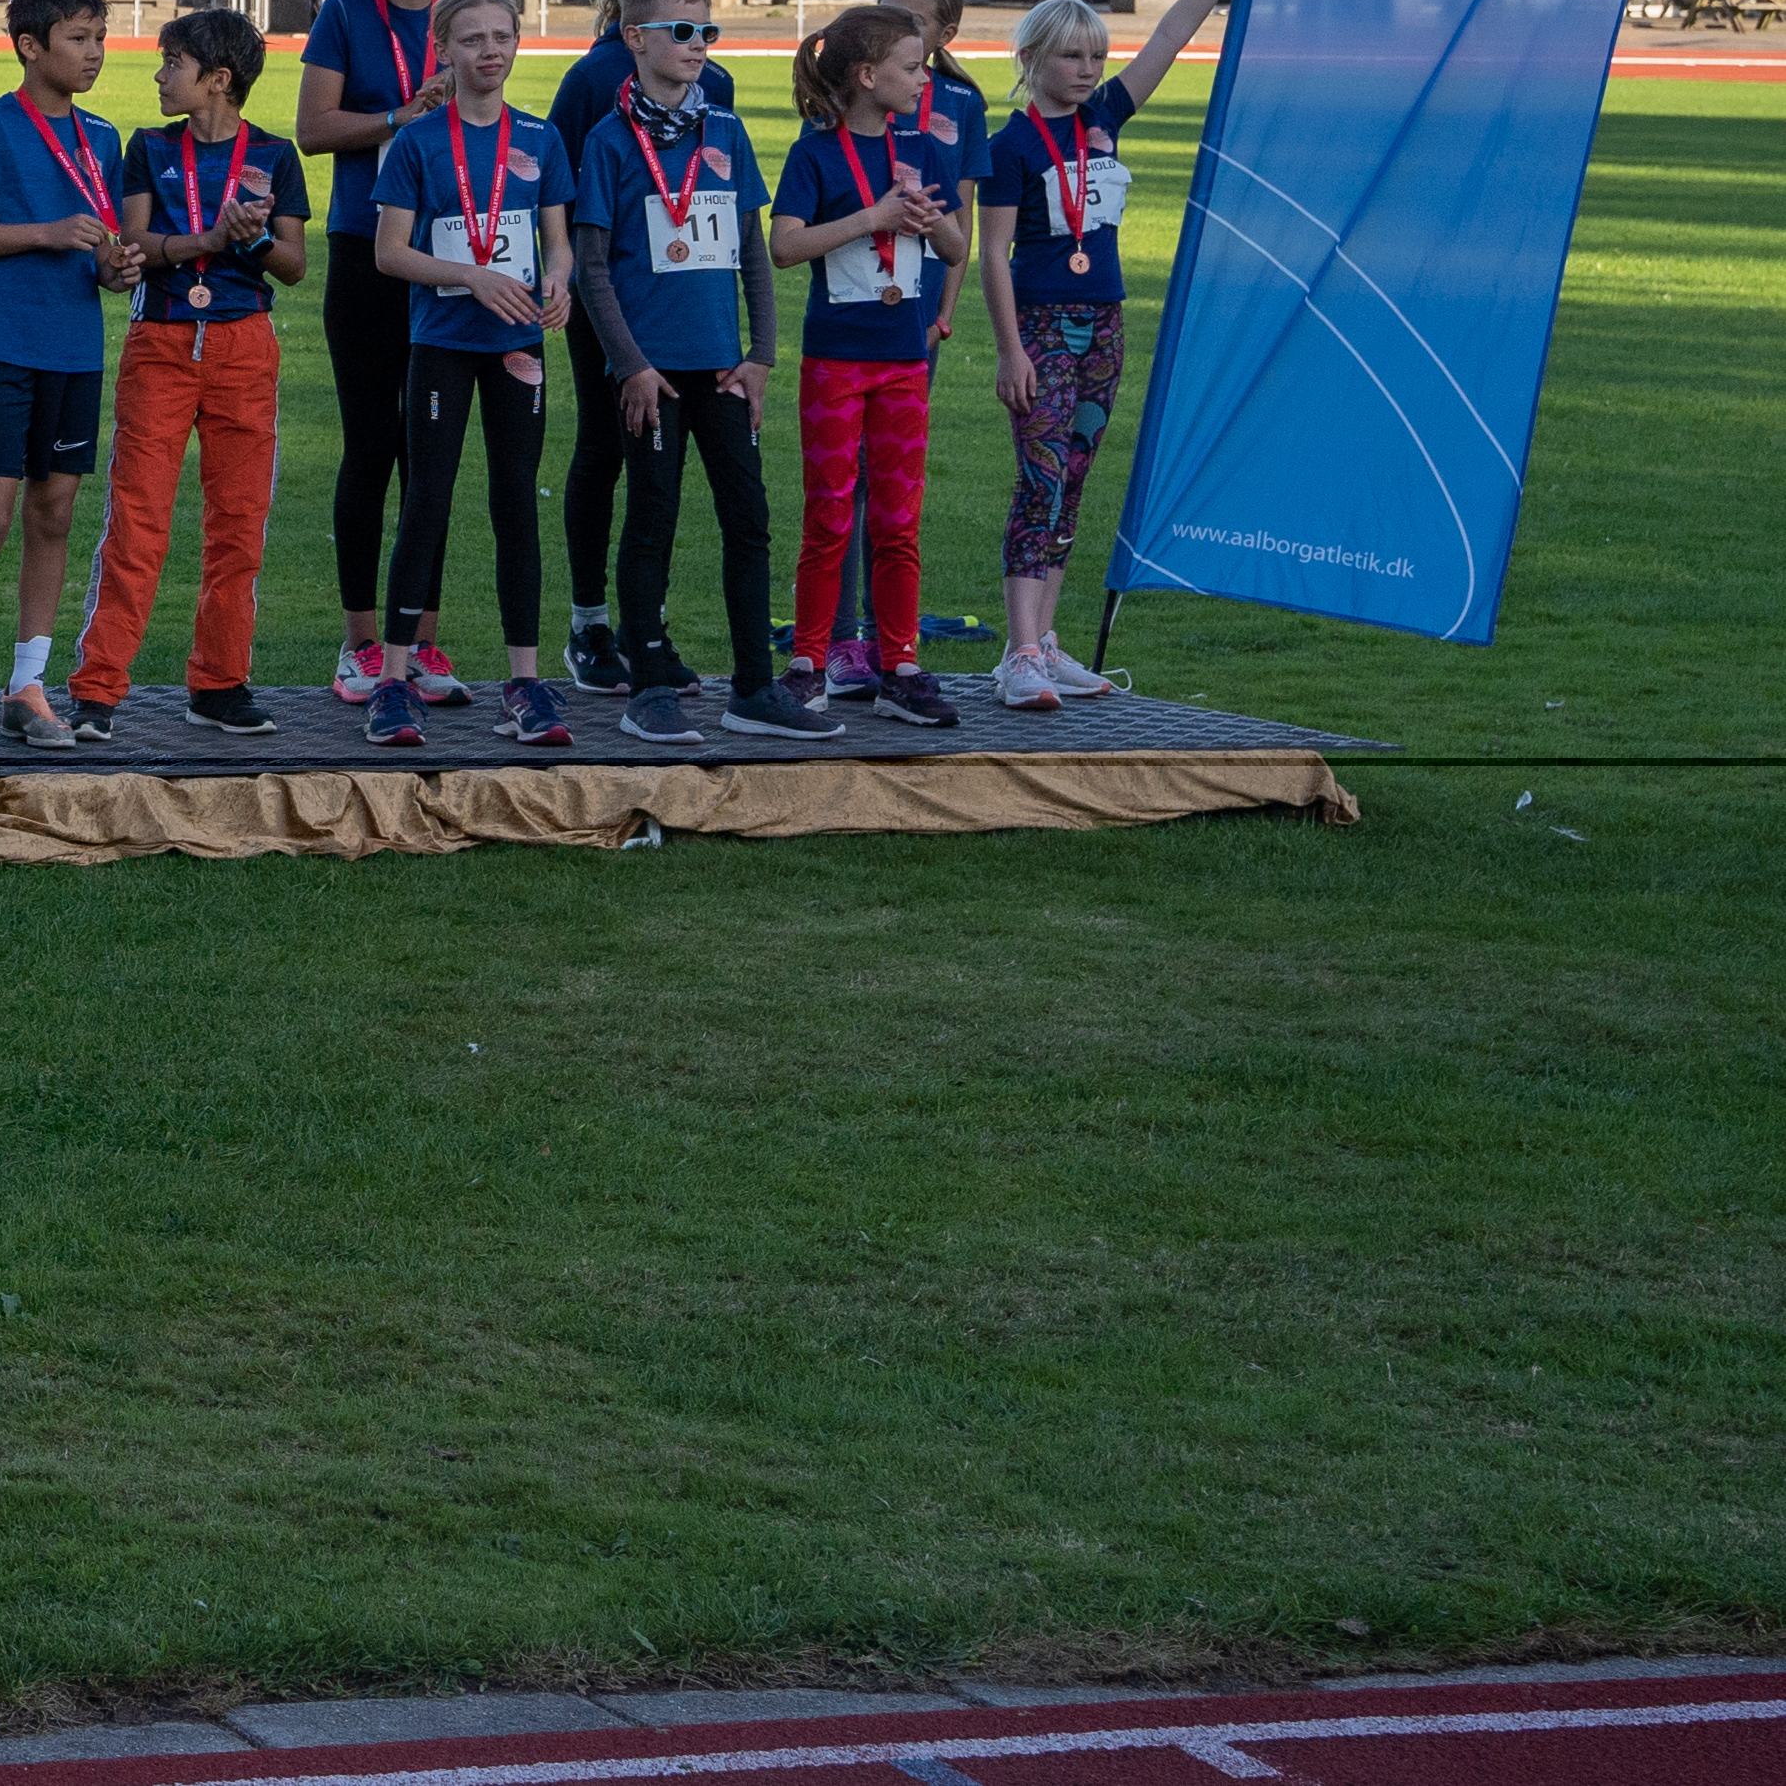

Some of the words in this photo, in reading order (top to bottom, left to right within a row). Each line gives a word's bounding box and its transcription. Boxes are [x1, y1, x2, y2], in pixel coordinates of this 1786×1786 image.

[516, 119, 544, 129] FUSION
[1086, 160, 1116, 173] HOLD
[1085, 179, 1102, 206] 5
[444, 217, 485, 232] VDU
[498, 215, 521, 227] OLD
[685, 213, 720, 242] 11
[467, 234, 512, 264] 2
[698, 254, 716, 262] 2022
[430, 391, 439, 420] FUSION
[1171, 523, 1415, 579] www.aalborgatletik.dk
